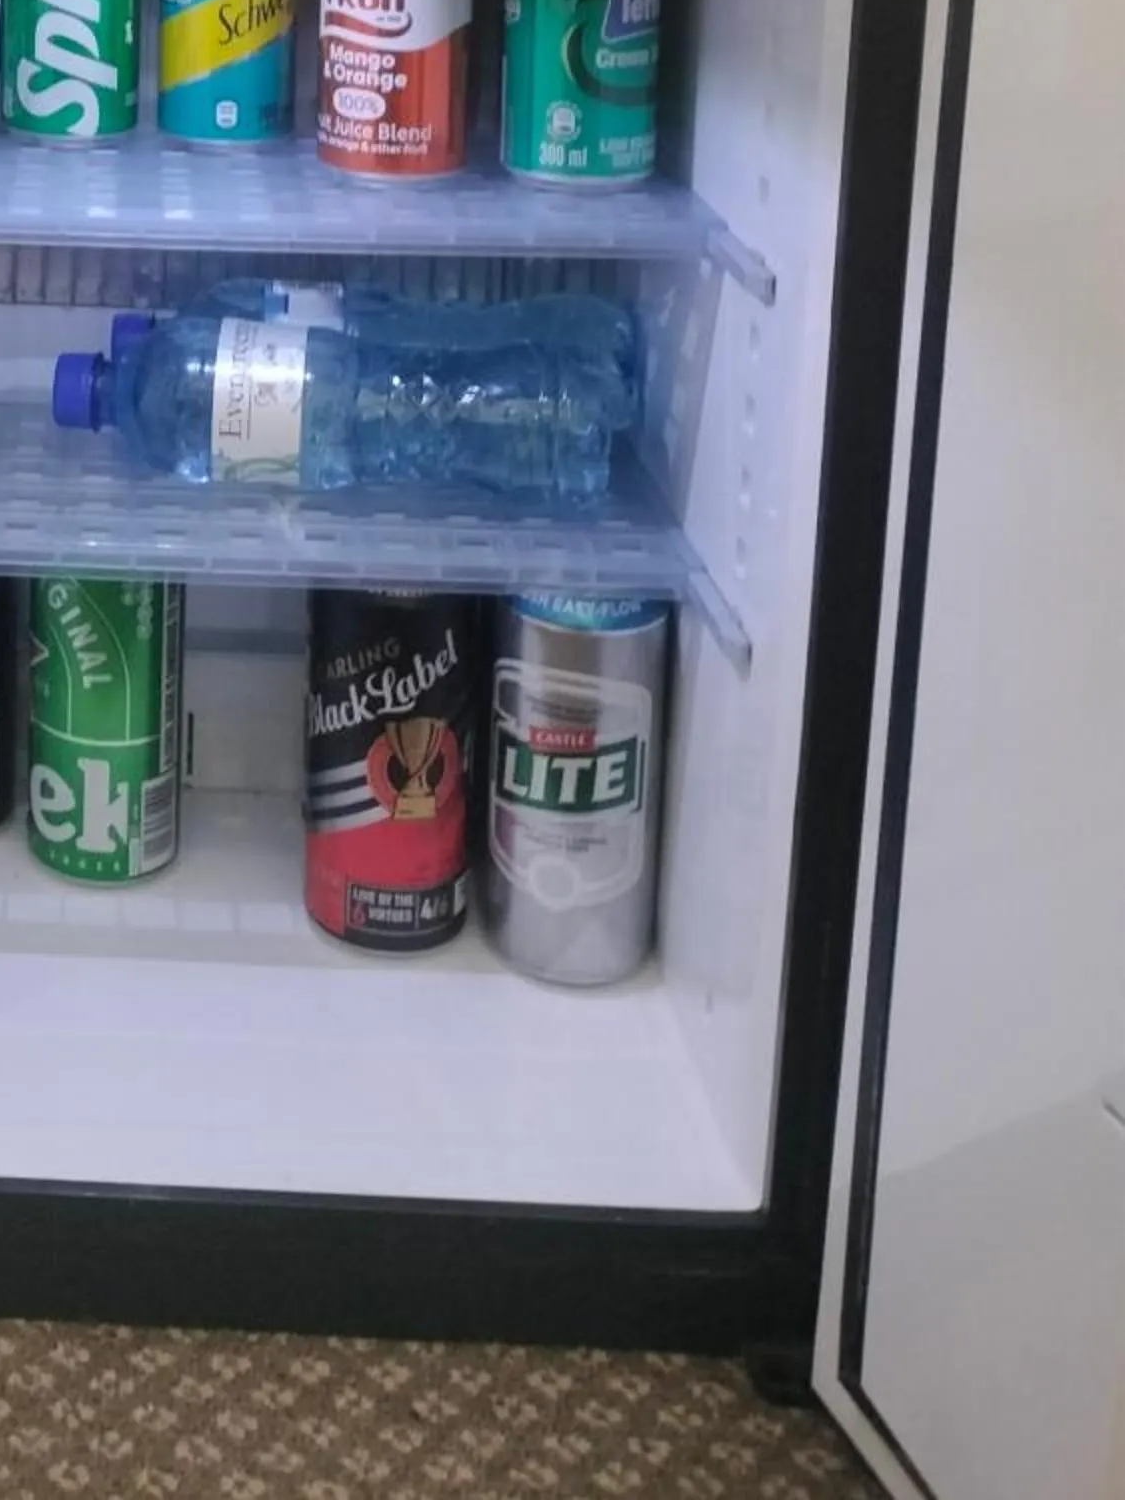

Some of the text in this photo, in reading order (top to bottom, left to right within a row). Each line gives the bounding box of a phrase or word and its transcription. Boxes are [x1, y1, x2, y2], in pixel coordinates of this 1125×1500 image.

[330, 41, 396, 74] Mango
[333, 62, 409, 94] Orange
[334, 115, 374, 141] Juice
[379, 122, 433, 145] Blend
[324, 636, 402, 680] ARLING
[365, 627, 458, 716] Label
[501, 745, 628, 806] LITE
